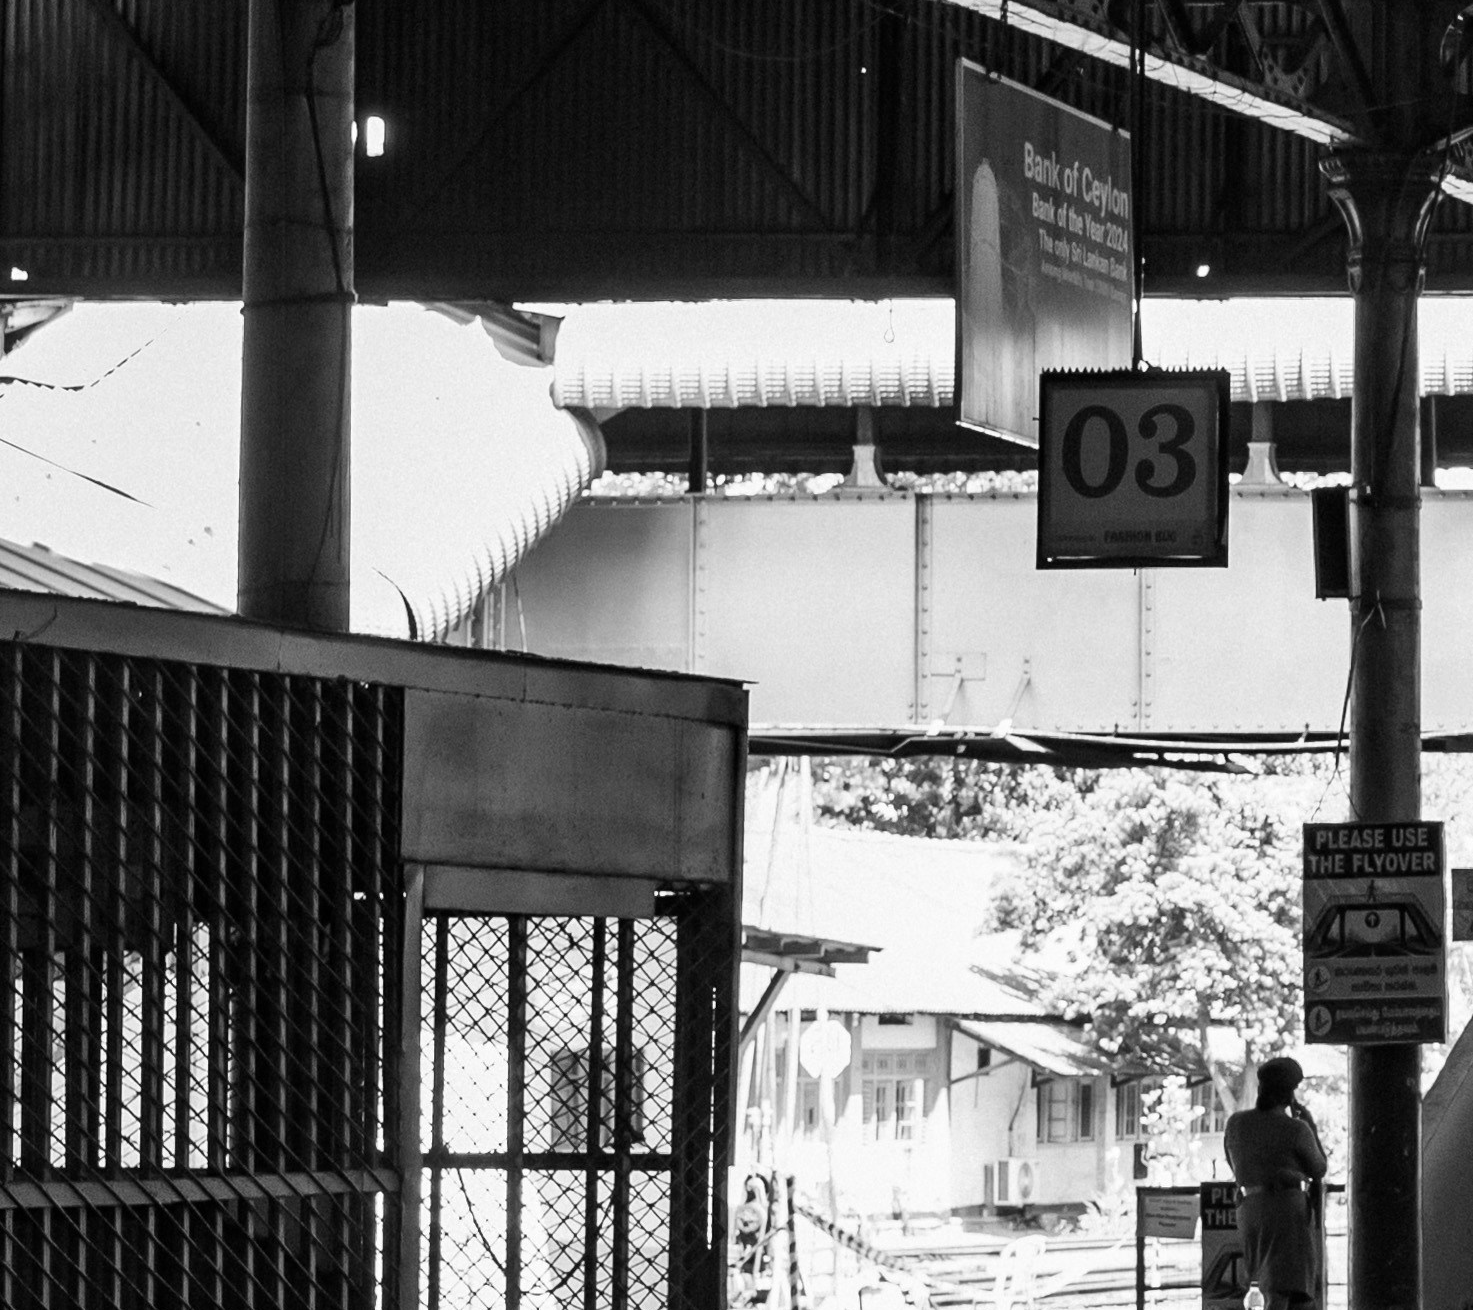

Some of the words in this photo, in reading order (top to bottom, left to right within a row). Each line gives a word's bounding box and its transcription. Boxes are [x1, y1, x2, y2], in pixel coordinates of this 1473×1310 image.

[1024, 141, 1060, 191] Bank
[1064, 161, 1079, 197] of
[1082, 167, 1128, 219] Ceylon
[1032, 192, 1056, 225] Bank
[1057, 202, 1067, 229] of
[1068, 204, 1083, 235] the
[1084, 213, 1105, 244] Year
[1061, 404, 1197, 499] 03
[1308, 853, 1346, 873] THE
[1352, 851, 1436, 872] FLYOVER
[1316, 828, 1385, 850] PLEASE
[1391, 827, 1429, 848] USE
